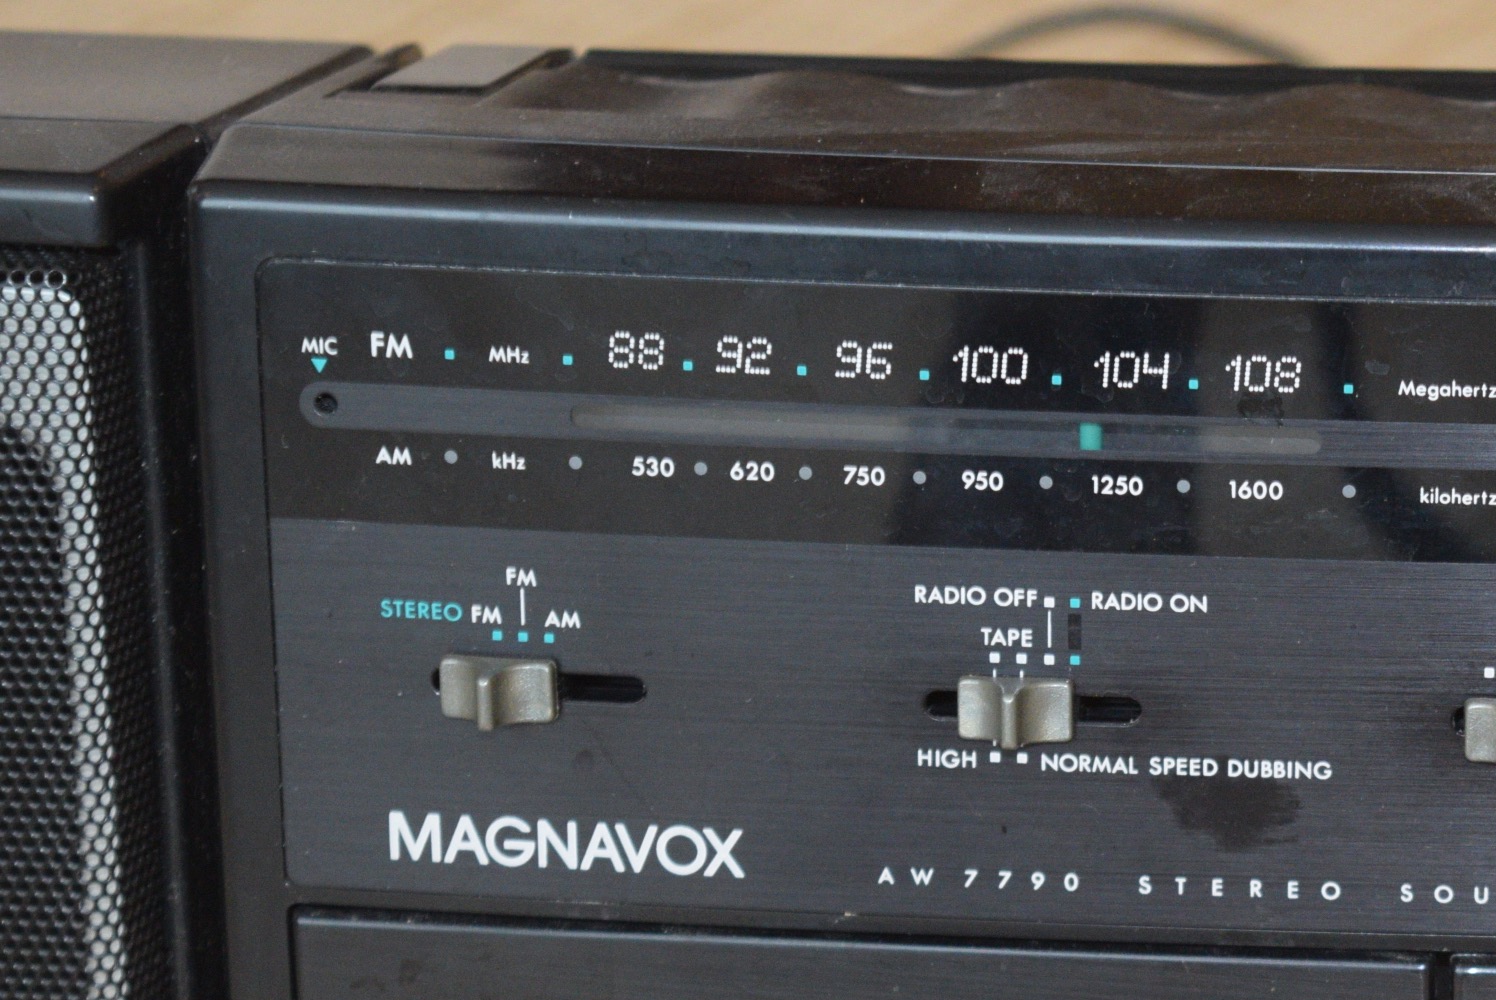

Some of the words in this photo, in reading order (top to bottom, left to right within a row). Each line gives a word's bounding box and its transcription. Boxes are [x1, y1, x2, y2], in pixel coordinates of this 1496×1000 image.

[301, 336, 338, 356] MIC
[370, 331, 413, 359] FM
[488, 346, 530, 365] MHz
[608, 331, 665, 371] 88
[715, 335, 773, 375] 92
[834, 340, 893, 380] 96
[952, 345, 1029, 385] 100
[1093, 351, 1170, 390] 104
[1225, 355, 1302, 394] 108
[375, 446, 412, 466] AM
[491, 451, 526, 471] kHz
[631, 456, 675, 478] 530
[729, 461, 775, 482] 620
[843, 465, 886, 487] 750
[961, 469, 1004, 492] 950
[1091, 474, 1144, 496] 1250
[1229, 479, 1284, 501] 1600
[505, 566, 537, 587] FM
[914, 584, 987, 606] RADIO
[993, 587, 1038, 608] OFF
[1091, 590, 1163, 612] RADIO
[1169, 593, 1208, 613] ON
[380, 598, 463, 622] STEREO
[471, 604, 503, 625] FM
[544, 610, 581, 629] AM
[980, 627, 1033, 648] TAPE
[917, 748, 977, 769] HIGH
[1040, 753, 1139, 775] NORMAL
[1148, 756, 1219, 777] SPEED
[1227, 758, 1333, 781] DUBBING
[388, 810, 745, 879] MAGNAVOX
[1138, 875, 1342, 901] STEREO
